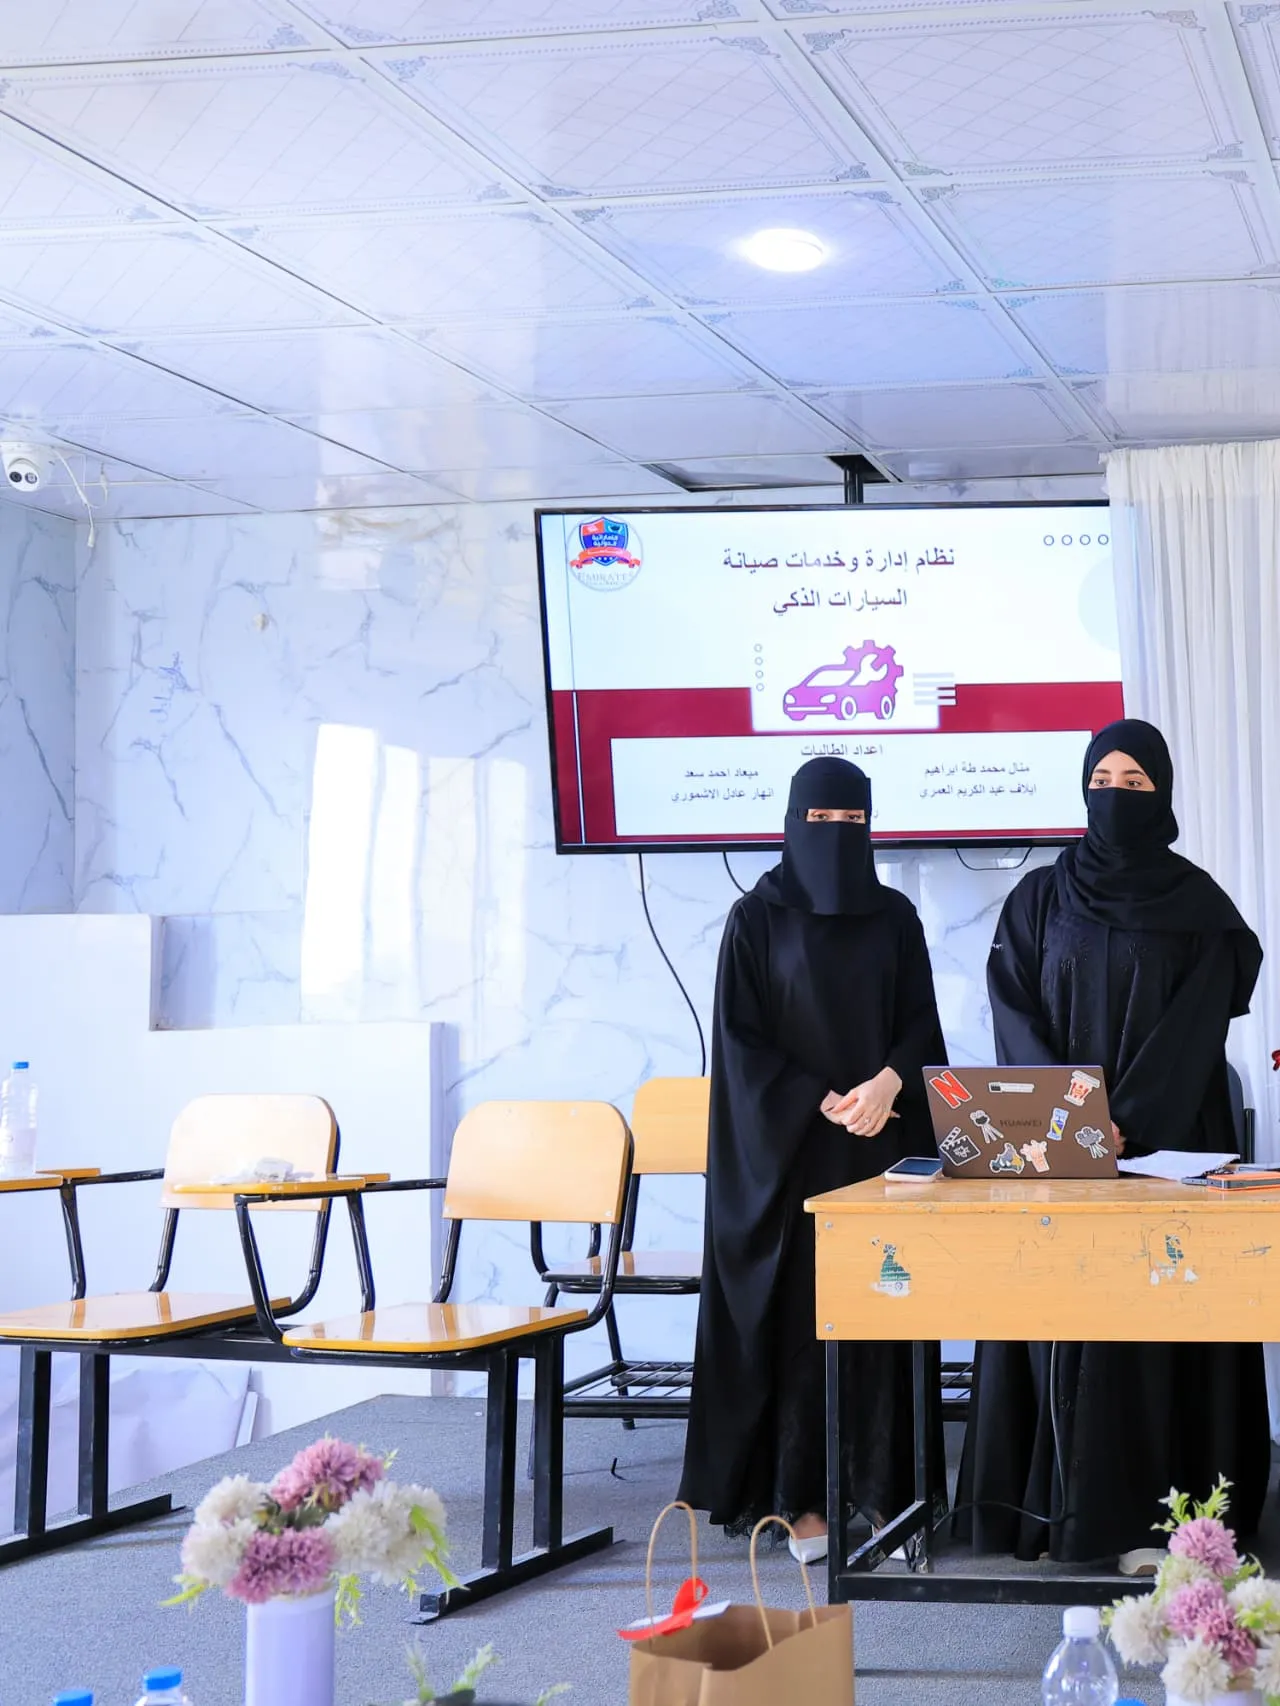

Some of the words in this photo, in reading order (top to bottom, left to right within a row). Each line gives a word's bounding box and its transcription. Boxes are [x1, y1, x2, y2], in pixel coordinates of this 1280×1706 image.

[723, 548, 778, 574] صيانة
[865, 549, 908, 573] إدارة
[915, 548, 955, 574] نظام
[773, 587, 820, 616] الذكي
[828, 588, 907, 612] السيارات
[684, 769, 704, 778] سعد
[708, 767, 730, 778] احمد
[979, 764, 1006, 774] محمد
[1008, 762, 1030, 775] منال
[723, 788, 746, 799] عادل
[956, 784, 985, 797] الكريم
[989, 785, 1004, 795] عبد
[930, 1070, 972, 1108] N
[1000, 1119, 1042, 1128] HUAWEI
